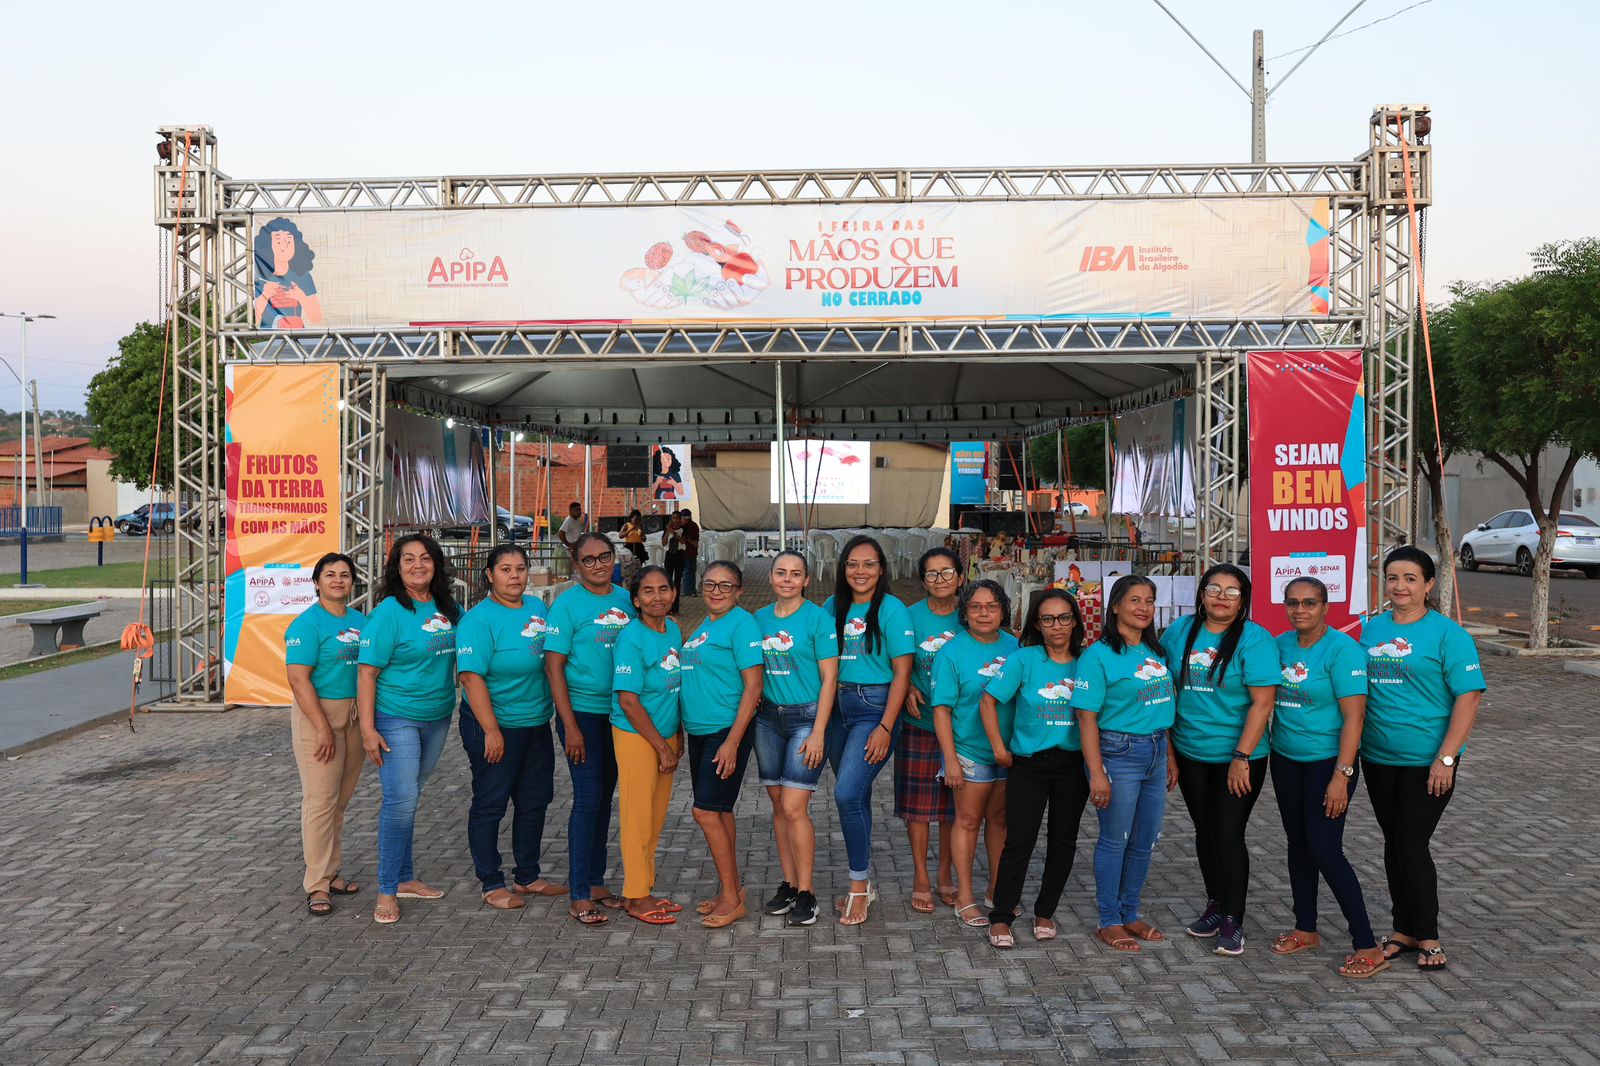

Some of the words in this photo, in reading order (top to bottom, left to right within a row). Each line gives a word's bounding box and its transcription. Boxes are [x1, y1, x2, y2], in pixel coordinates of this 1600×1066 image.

[818, 221, 823, 232] I
[831, 220, 884, 232] FEIRA
[892, 219, 925, 231] DAS
[788, 232, 880, 262] MÃOS
[890, 237, 955, 266] QUE
[1139, 246, 1173, 254] Instituto
[1079, 245, 1136, 272] IBA
[1139, 254, 1179, 263] Brasileiro
[427, 255, 509, 283] APIPA
[1153, 263, 1189, 273] Algodão
[784, 265, 959, 290] PRODUZEM
[821, 292, 843, 307] NO
[849, 290, 922, 307] CERRADO
[1275, 443, 1339, 466] SEJAM
[246, 454, 318, 475] FRUTOS
[241, 479, 265, 498] DA
[268, 479, 325, 498] TERRA
[1273, 469, 1342, 505] BEM
[239, 502, 328, 514] TRANSFORMADOS
[241, 520, 269, 534] COM
[271, 520, 287, 534] AS
[290, 518, 326, 534] MÃOS
[1267, 507, 1349, 532] VINDOS
[1275, 566, 1302, 576] APIPA
[249, 576, 276, 586] APIPA
